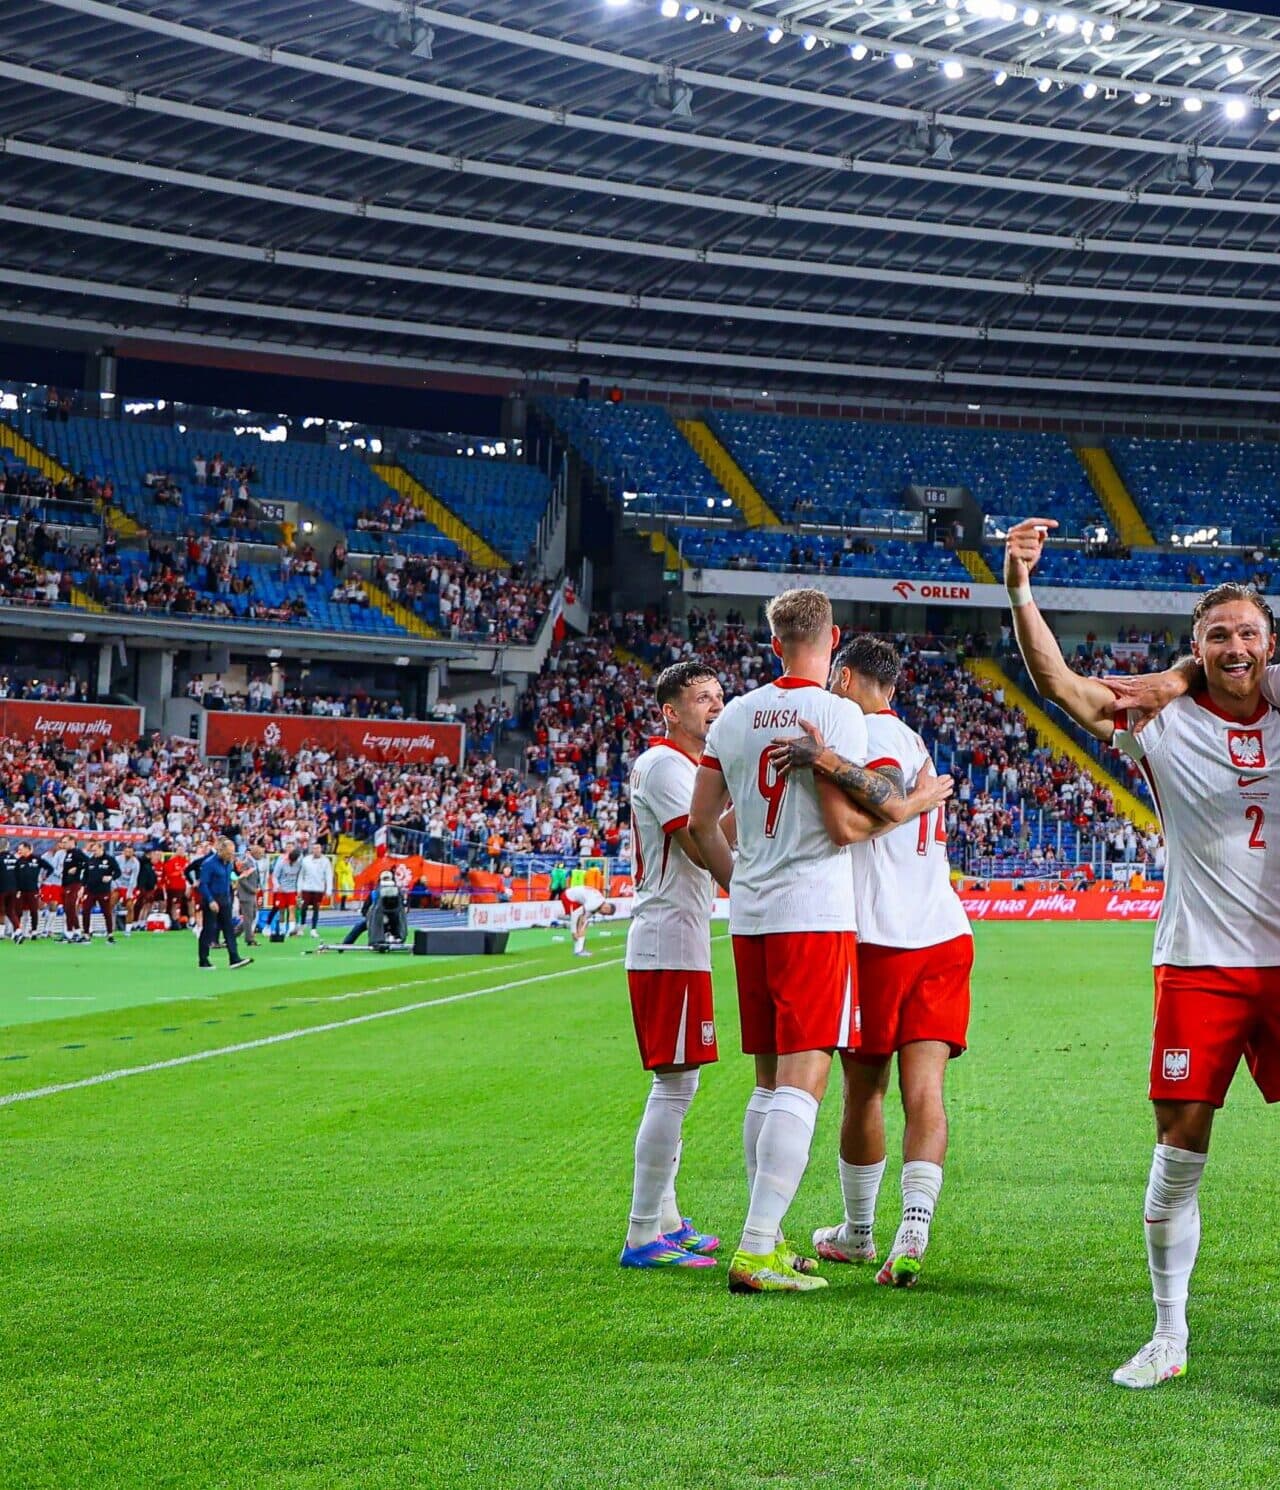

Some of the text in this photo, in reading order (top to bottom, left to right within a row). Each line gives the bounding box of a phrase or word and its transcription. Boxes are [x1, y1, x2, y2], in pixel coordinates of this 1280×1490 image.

[921, 586, 970, 599] ORLEN
[753, 709, 798, 729] BUKSA
[758, 744, 789, 839] 9
[1245, 805, 1267, 849] 2
[992, 899, 1027, 913] nas
[1027, 894, 1077, 917] piłka
[1106, 895, 1162, 917] Łączy
